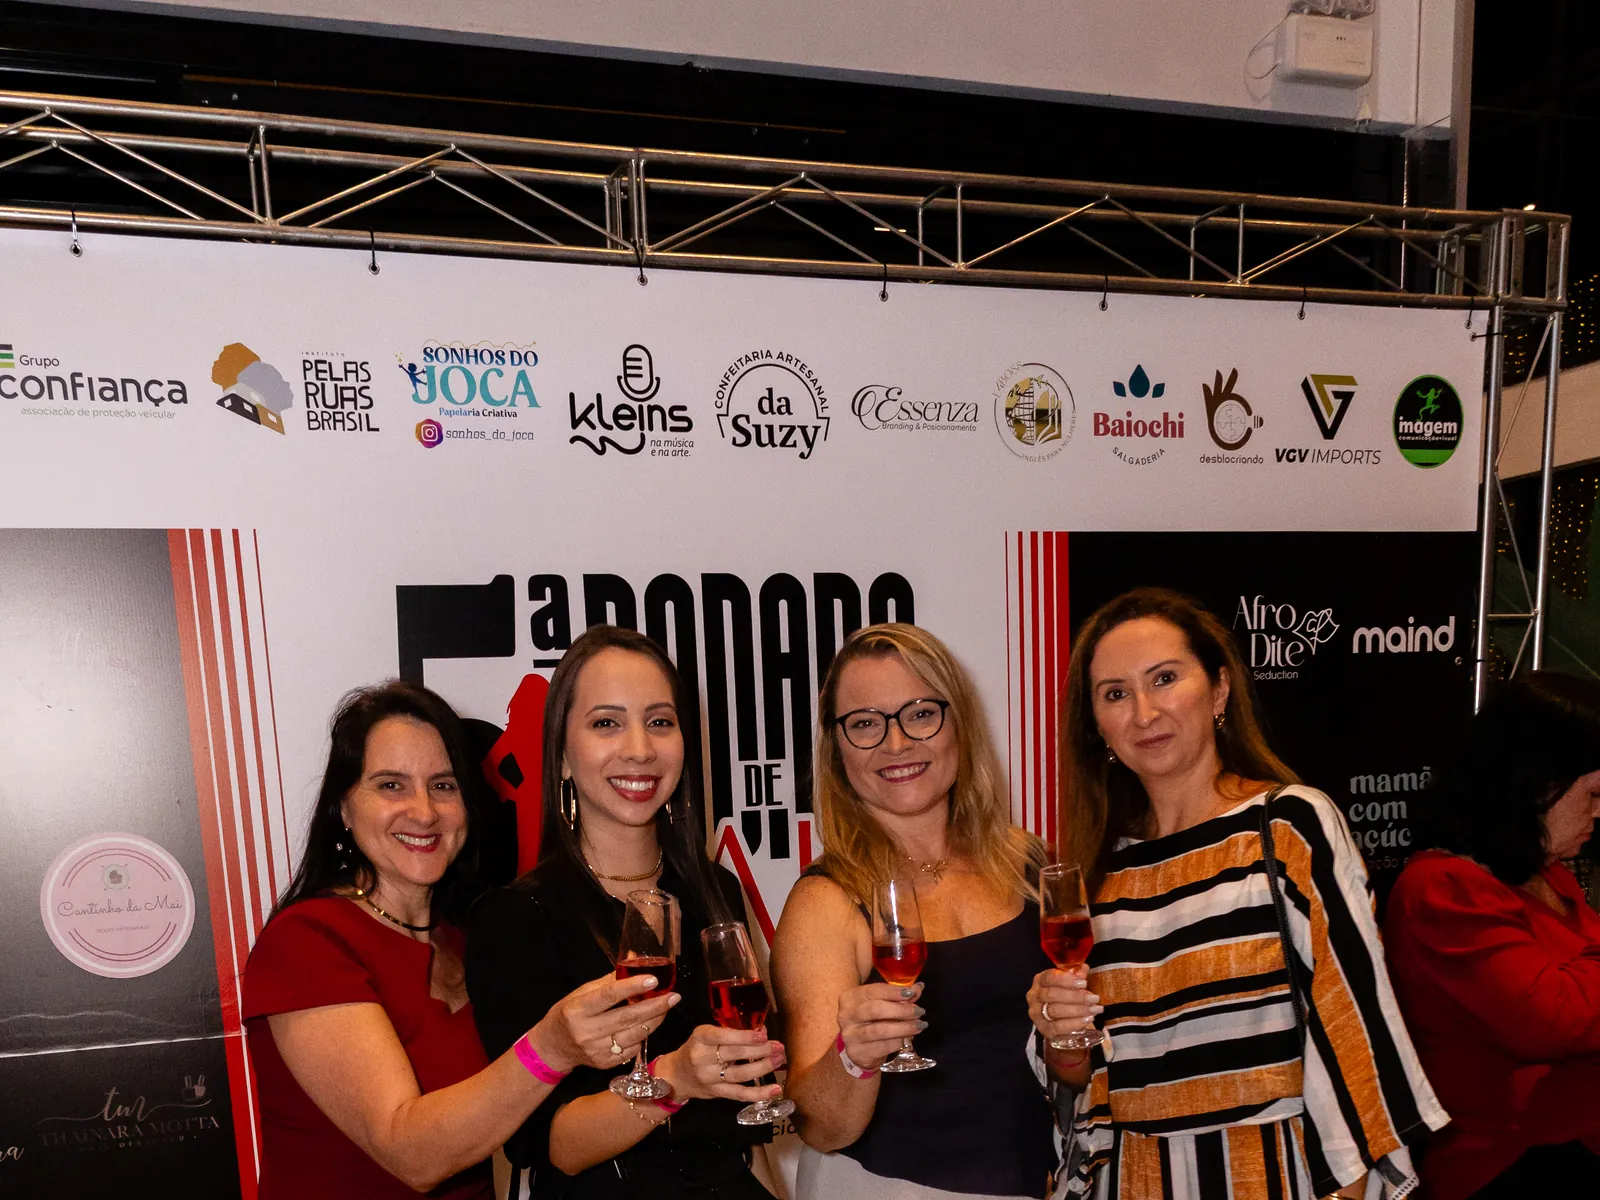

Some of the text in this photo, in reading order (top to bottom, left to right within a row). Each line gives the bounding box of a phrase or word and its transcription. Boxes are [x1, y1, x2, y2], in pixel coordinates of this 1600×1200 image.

[19, 354, 60, 369] Grupo
[423, 347, 538, 367] SONHOS DO
[302, 359, 372, 382] PELAS
[715, 350, 829, 413] CONFEITARIA ARTESANAL
[304, 381, 374, 410] RUAS
[412, 365, 541, 408] JOCA
[758, 387, 793, 415] da
[21, 407, 177, 419] associação de proteção veicular
[307, 410, 380, 432] BRASIL
[439, 407, 518, 418] Papelaria Criativa
[446, 428, 534, 441] sonhos_do_joca
[882, 423, 914, 432] Branding
[922, 423, 977, 432] Posicionamento
[1093, 411, 1184, 438] Baiochi
[1398, 415, 1458, 437] imagem
[650, 437, 694, 448] na música
[732, 414, 821, 460] Suzy
[651, 449, 692, 457] e na arte.
[1112, 446, 1166, 466] SALGADERIA
[1275, 448, 1382, 465] VGV IMPORTS
[1233, 594, 1297, 630] Afro
[1352, 616, 1455, 654] maind
[1251, 633, 1305, 668] Dite
[1253, 670, 1299, 681] Seduction
[744, 763, 784, 807] DE
[1350, 766, 1434, 794] mamã
[1349, 800, 1408, 822] com
[57, 898, 123, 917] Cantinho
[126, 898, 142, 912] da
